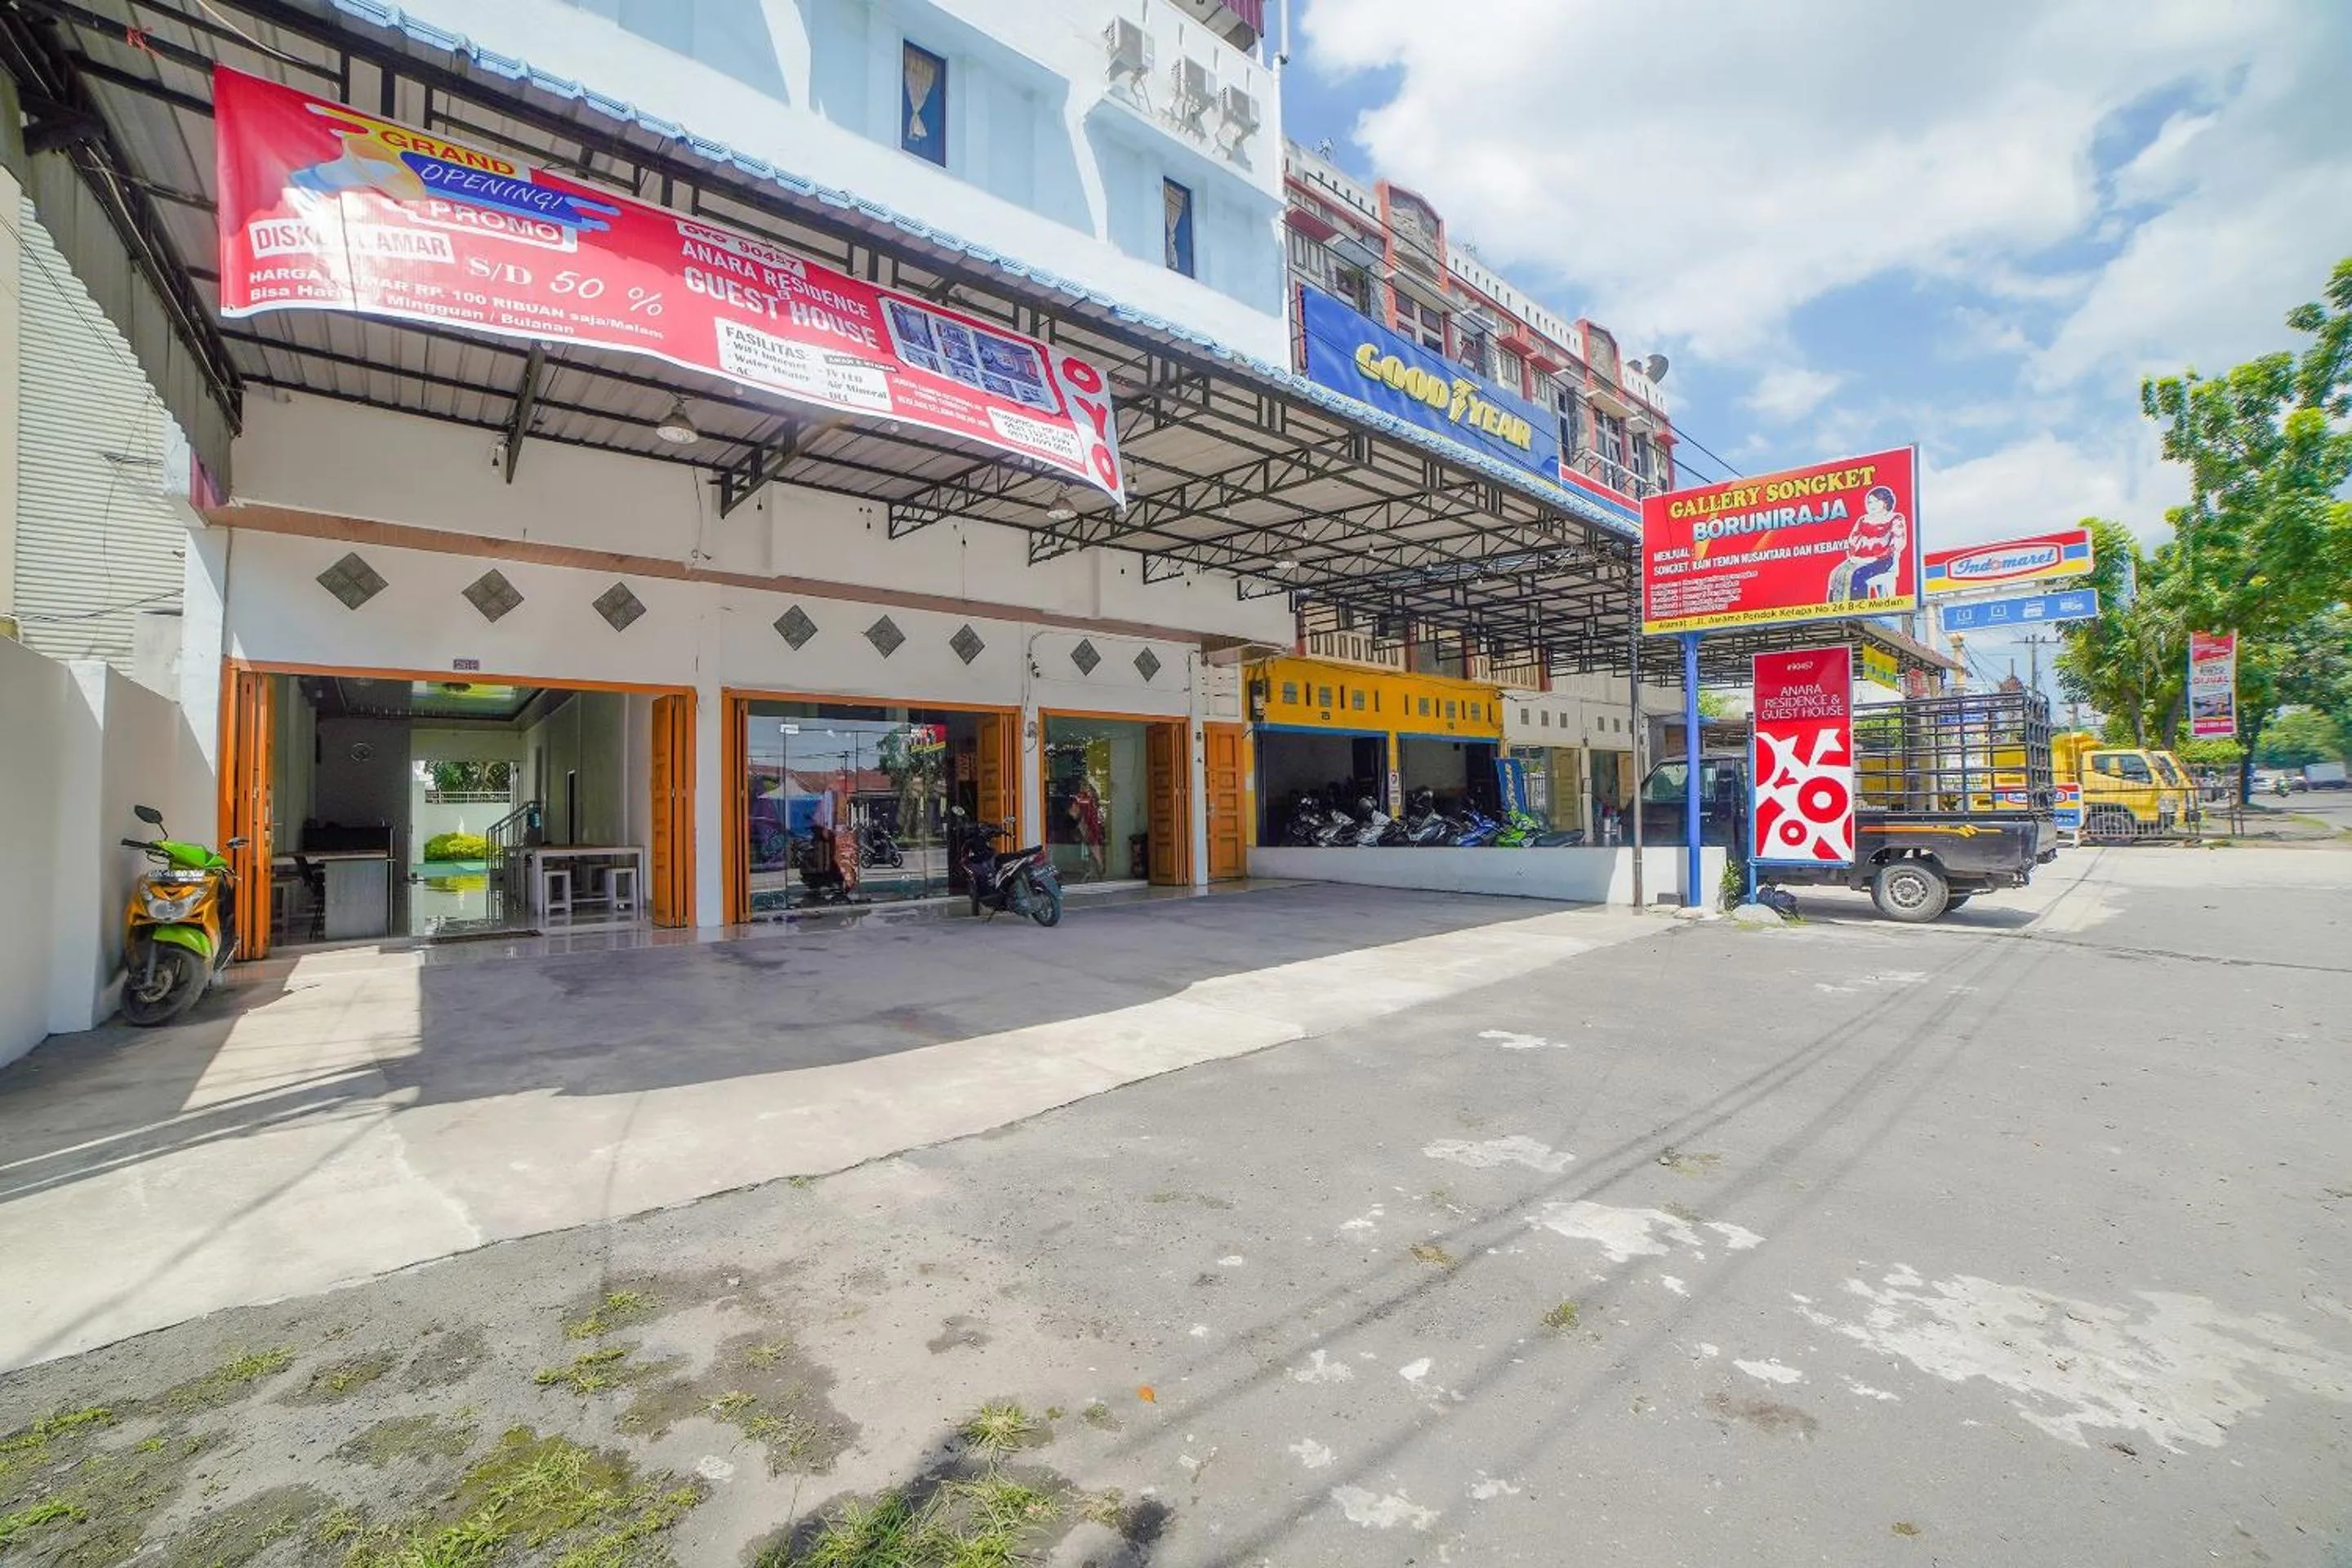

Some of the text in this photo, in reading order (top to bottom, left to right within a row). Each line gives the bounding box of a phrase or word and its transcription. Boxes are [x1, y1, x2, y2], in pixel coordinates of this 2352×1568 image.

[380, 131, 514, 175] GRAND
[421, 163, 563, 211] OPENING!
[430, 202, 559, 241] PROMO
[249, 268, 323, 283] HARGA
[452, 289, 488, 305] 100
[492, 296, 565, 318] RIBUAN
[468, 256, 662, 316] S/D 50 %
[682, 240, 871, 320] ANARA RESIDENCE
[250, 286, 290, 301] Bisa
[388, 295, 484, 320] Mingguan
[501, 313, 575, 334] Bulanan
[684, 267, 880, 350] GUEST HOUSE
[1669, 466, 1876, 519] GALLERY SONGKET
[1692, 498, 1849, 541] BORUNIRAJA
[1742, 547, 1791, 564] NUSANTARA
[1793, 545, 1811, 557] DAN
[1814, 540, 1849, 554] KEBAYA
[1954, 549, 2055, 575] Indomaret
[1743, 609, 1776, 621] Pondok
[1833, 604, 1844, 612] 26
[1869, 599, 1904, 609] Medan
[1765, 694, 1840, 709] RESIDENCE &
[1781, 684, 1822, 697] ANARA
[1762, 705, 1844, 720] GUEST HOUSE
